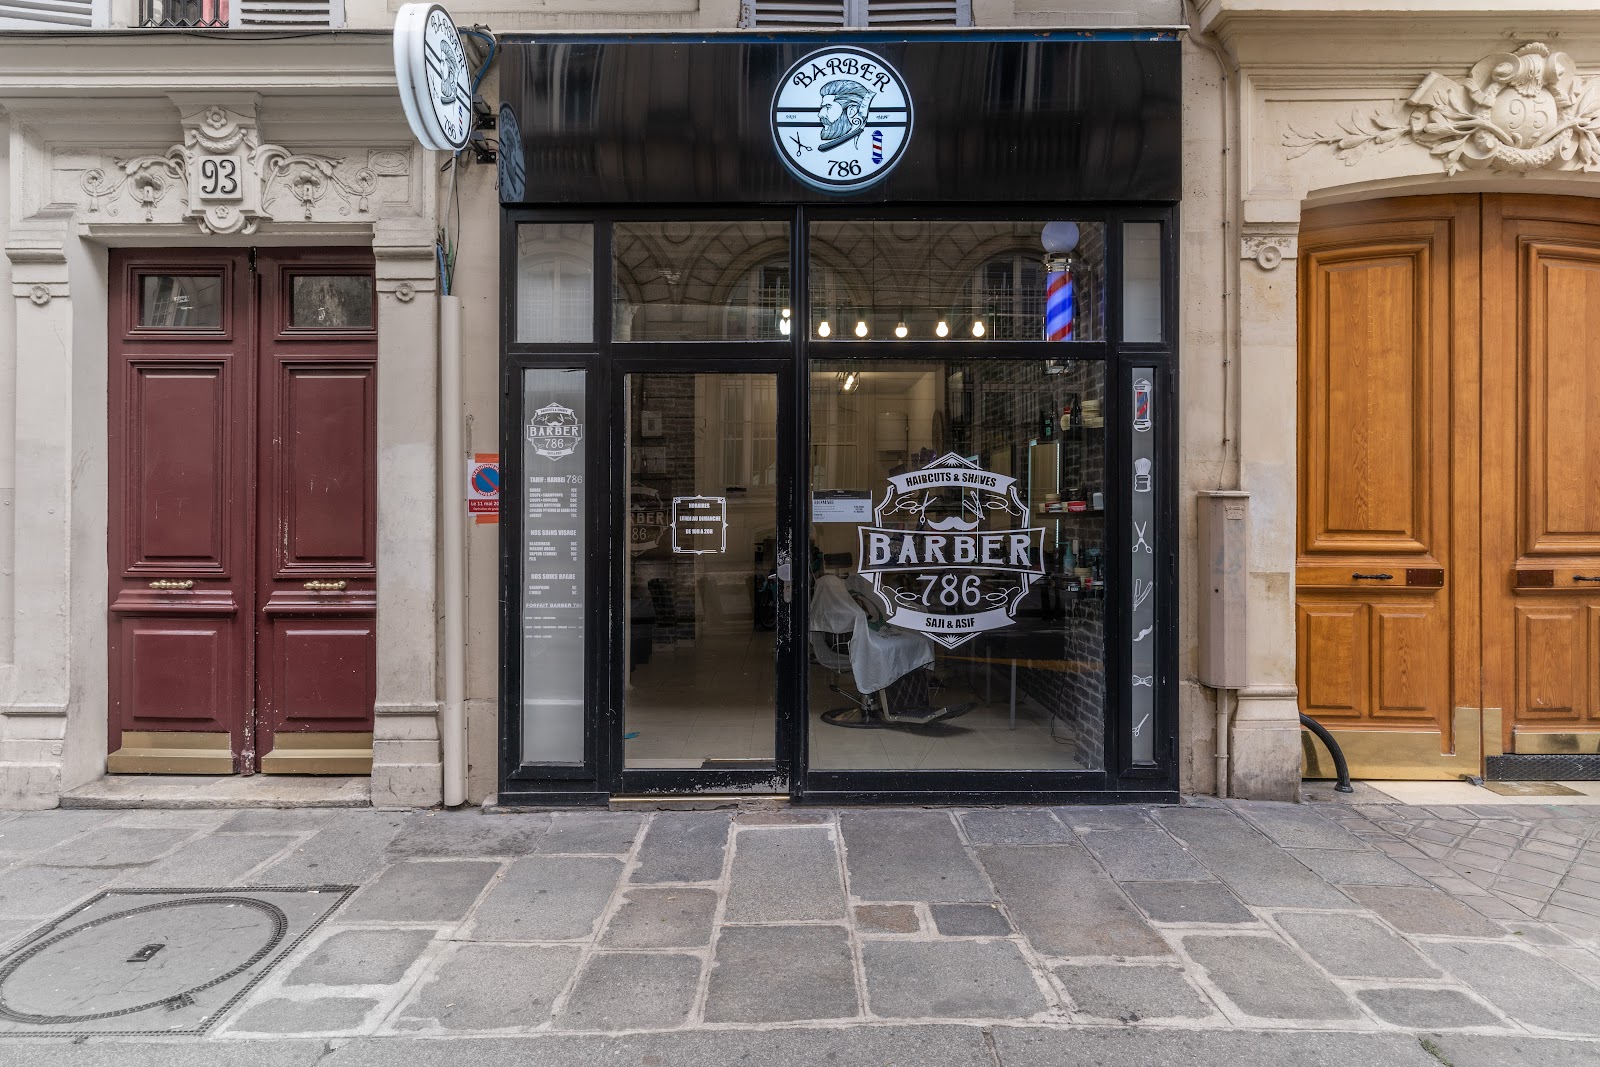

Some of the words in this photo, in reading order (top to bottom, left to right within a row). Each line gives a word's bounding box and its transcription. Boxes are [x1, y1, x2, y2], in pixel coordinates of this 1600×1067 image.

[431, 14, 465, 74] BARBER
[792, 57, 891, 93] BARBER
[443, 114, 457, 141] 786
[201, 159, 238, 194] 93
[827, 159, 862, 177] 786
[529, 426, 579, 437] BARBER
[544, 438, 564, 449] 786
[566, 474, 583, 484] 786
[905, 471, 952, 488] HAIRCUTS
[953, 473, 960, 482] &
[962, 472, 997, 488] SHAVES
[869, 532, 1033, 567] BARBER
[915, 573, 982, 606] 786
[925, 617, 945, 628] SAJI
[946, 620, 954, 628] &
[955, 617, 975, 629] ASIF
